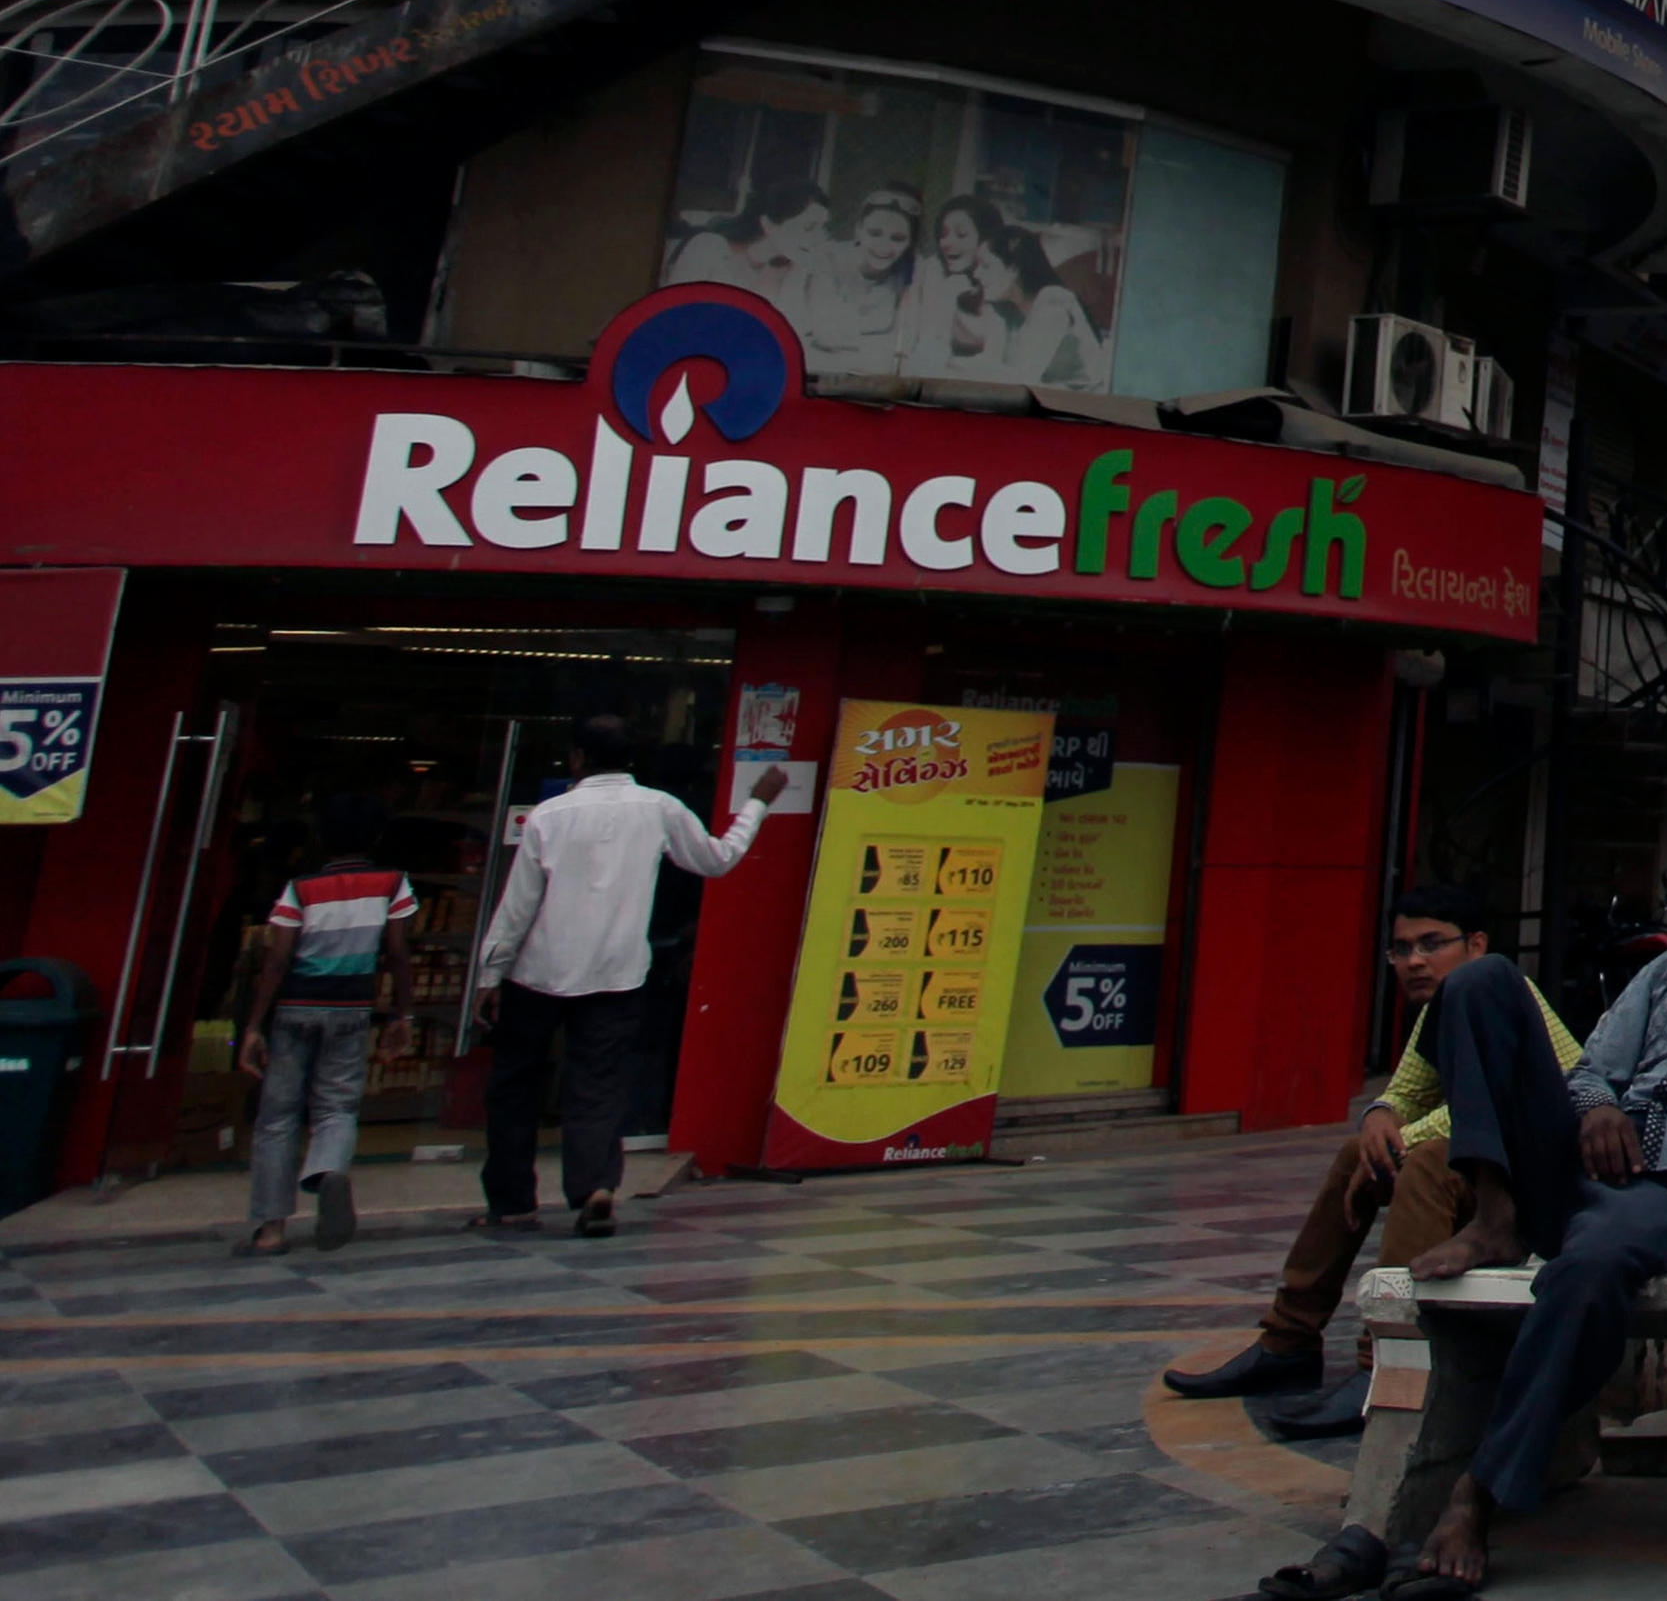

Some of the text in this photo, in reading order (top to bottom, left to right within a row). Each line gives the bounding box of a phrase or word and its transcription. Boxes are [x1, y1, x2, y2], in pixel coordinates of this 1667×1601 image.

[353, 411, 1367, 598] Reliance fresh
[1392, 547, 1497, 610] રિલાયન્સ
[2, 690, 82, 703] Minimum
[854, 720, 962, 755] સમર
[1051, 734, 1081, 758] RP
[32, 752, 77, 771] OFF
[1069, 960, 1126, 974] Minimum
[938, 994, 977, 1010] FREE
[1060, 977, 1127, 1032] 5%
[1092, 1013, 1125, 1031] OFF
[883, 1144, 947, 1161] Reliance
